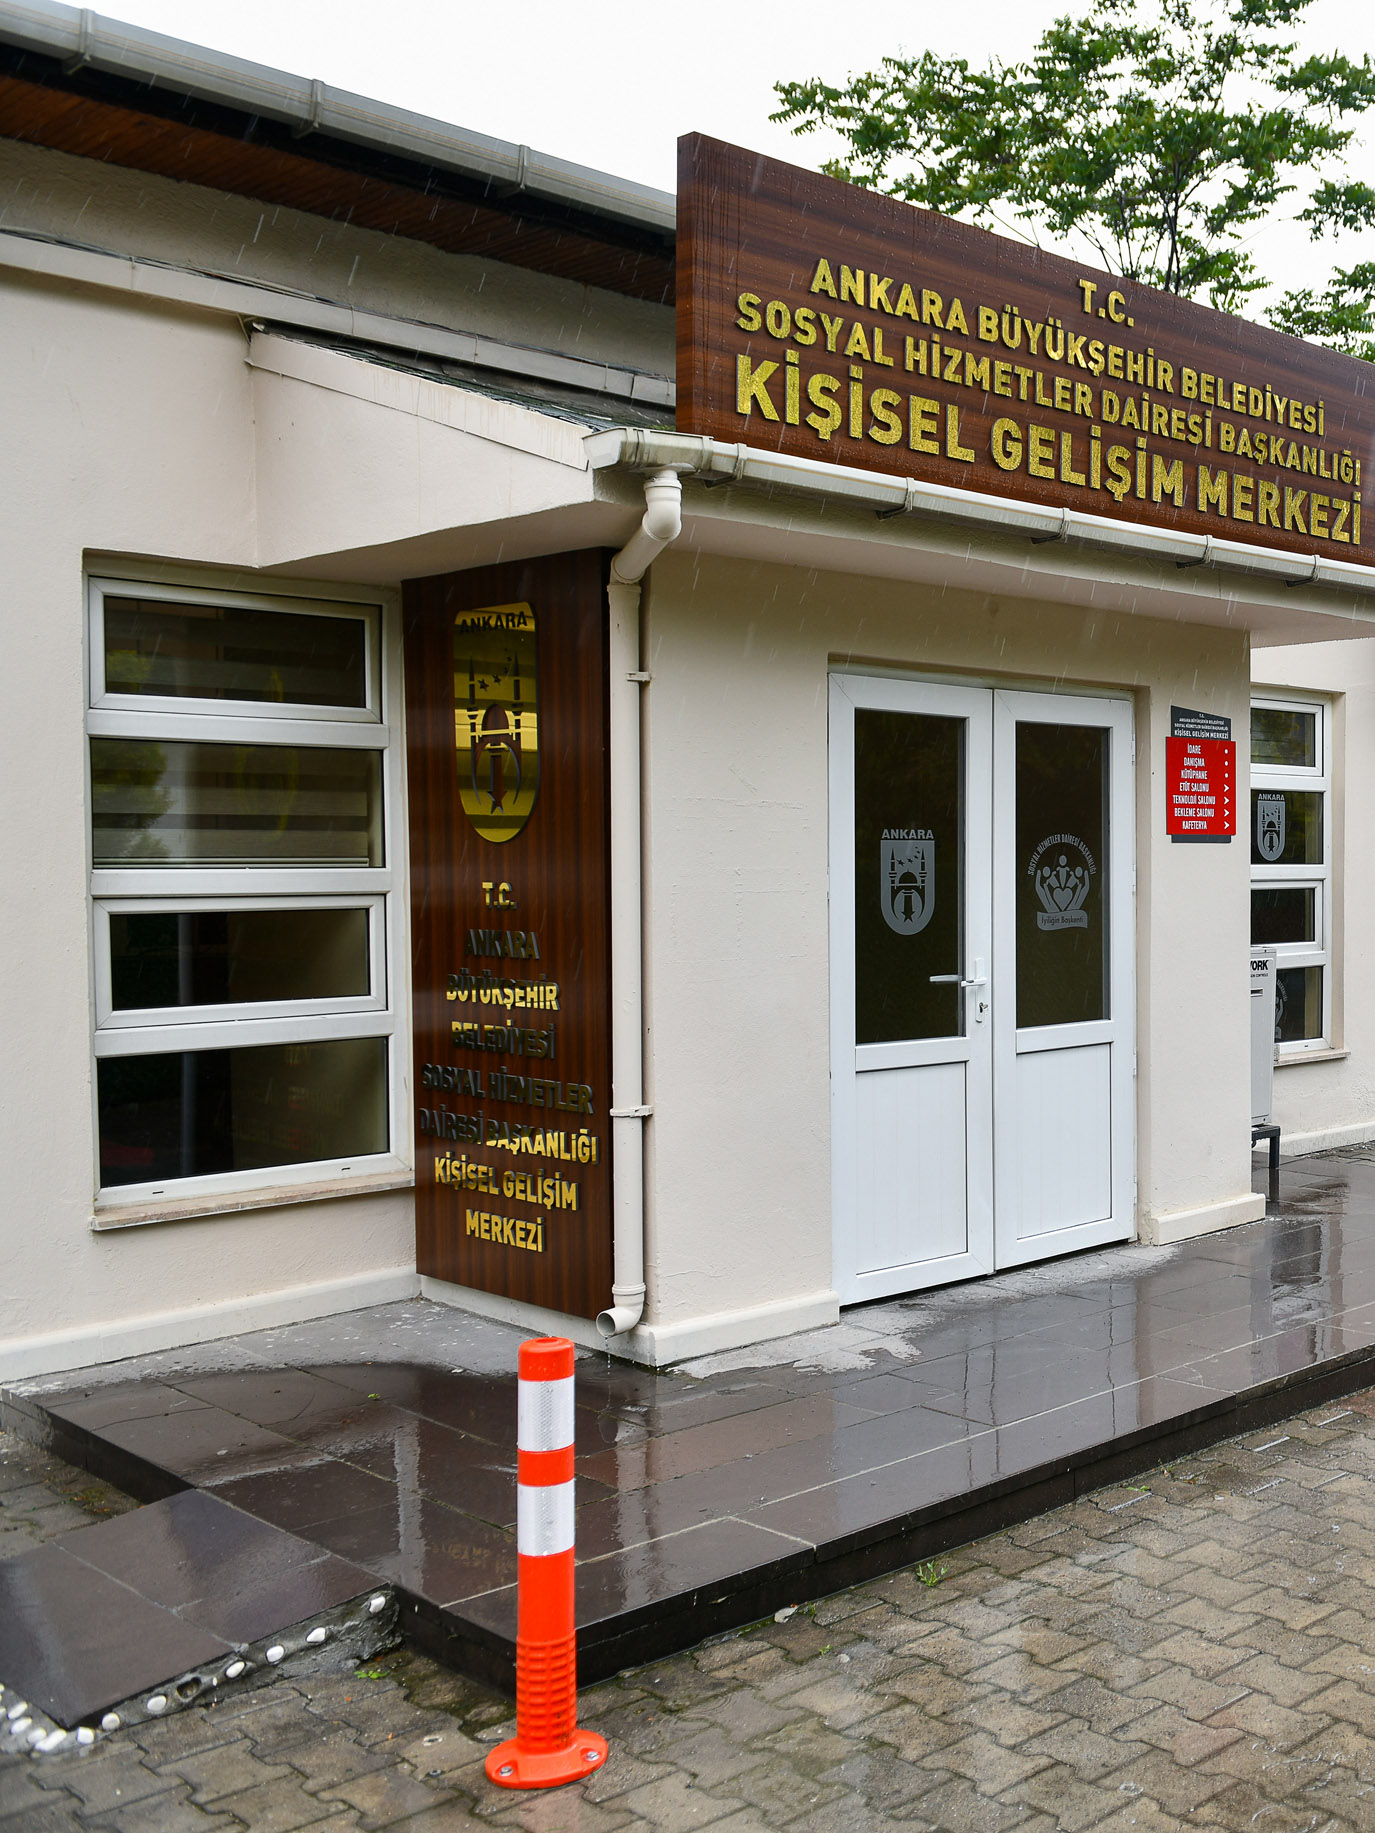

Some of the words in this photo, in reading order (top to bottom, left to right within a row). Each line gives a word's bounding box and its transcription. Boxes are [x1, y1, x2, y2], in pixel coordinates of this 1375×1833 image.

[1079, 278, 1135, 327] T.C.
[810, 258, 969, 336] ANKARA
[977, 304, 1174, 394] BÜYÜKŞEHİR
[1181, 366, 1324, 436] BELEDİYESİ
[736, 292, 894, 367] SOSYAL
[904, 332, 1094, 418] HİZMETLER
[1102, 389, 1212, 448] DAİRESİ
[1219, 421, 1361, 486] BAŞKANLIĞI
[735, 348, 975, 463] KİŞİSEL
[990, 417, 1184, 507] GELİŞİM
[1197, 464, 1361, 545] MERKEZİ
[460, 611, 527, 632] ANKARA
[1258, 793, 1285, 801] ANKARA
[881, 828, 934, 839] ANKARA
[482, 881, 517, 909] T.C.
[466, 928, 540, 960] ANKARA
[446, 968, 560, 1011] BÜYÜKŞEHİR
[451, 1019, 555, 1060] BELEDİYESİ
[421, 1063, 486, 1098] SOSYAL
[488, 1065, 594, 1115] HİZMETLER
[419, 1104, 484, 1145] DAİRESİ
[434, 1151, 500, 1196] KİŞİSEL
[503, 1168, 579, 1211] GELİŞİM
[465, 1208, 545, 1253] MERKEZİ
